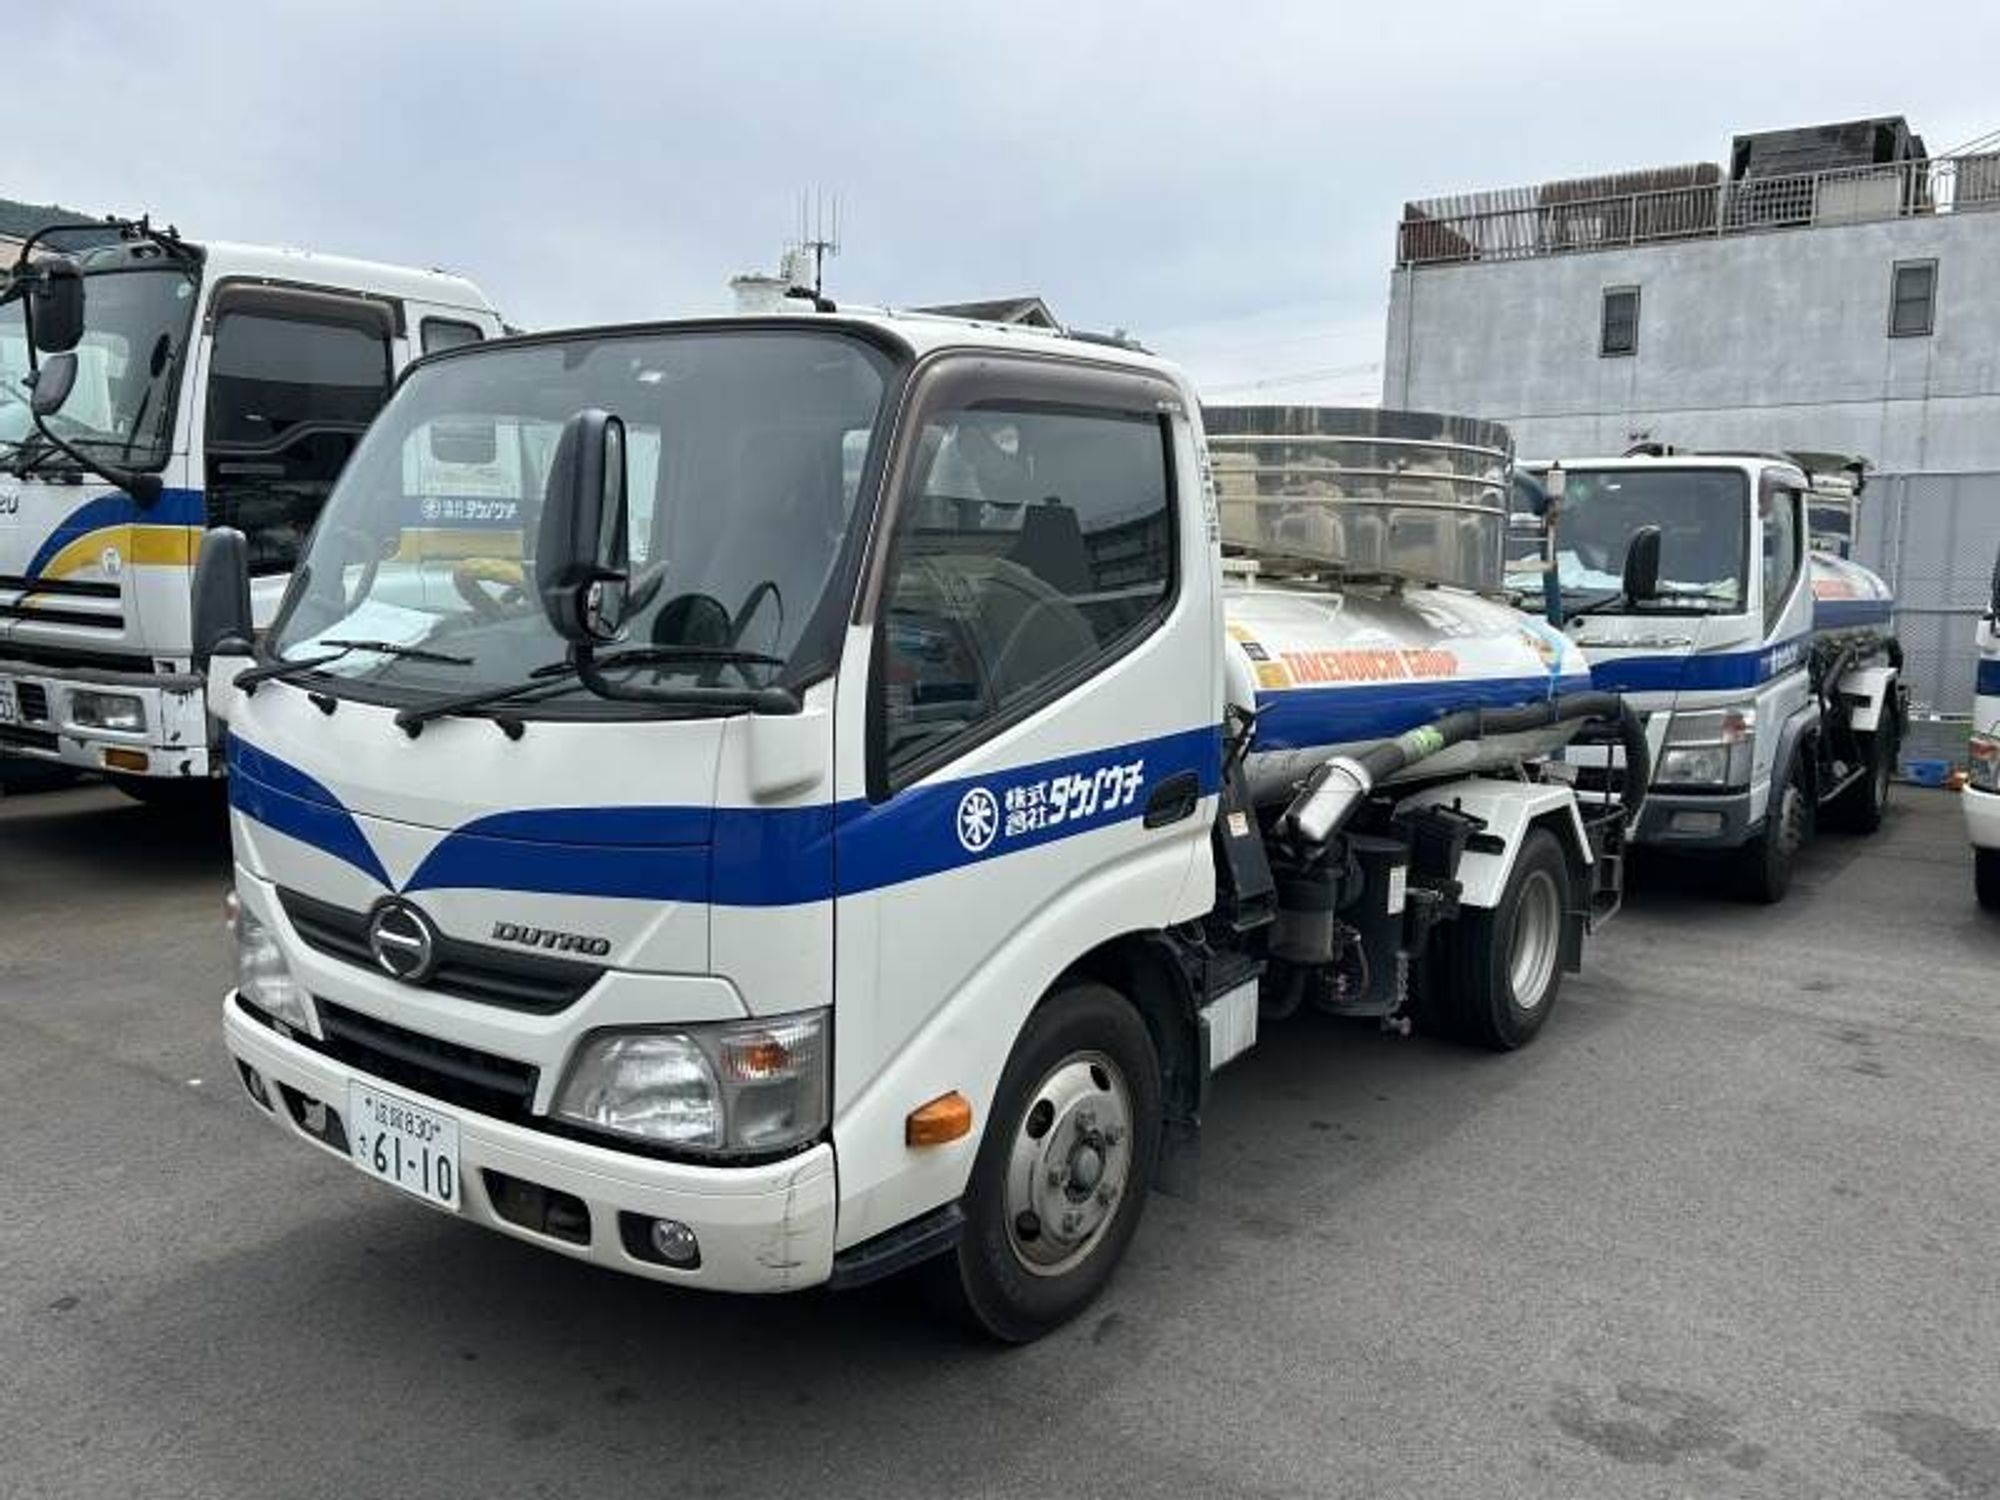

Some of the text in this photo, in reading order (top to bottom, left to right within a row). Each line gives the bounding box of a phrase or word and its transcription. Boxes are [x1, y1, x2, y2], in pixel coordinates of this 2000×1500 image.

[1049, 760, 1144, 824] タケノウチ
[493, 921, 611, 956] DUTRO
[375, 1132, 451, 1201] 61-10
